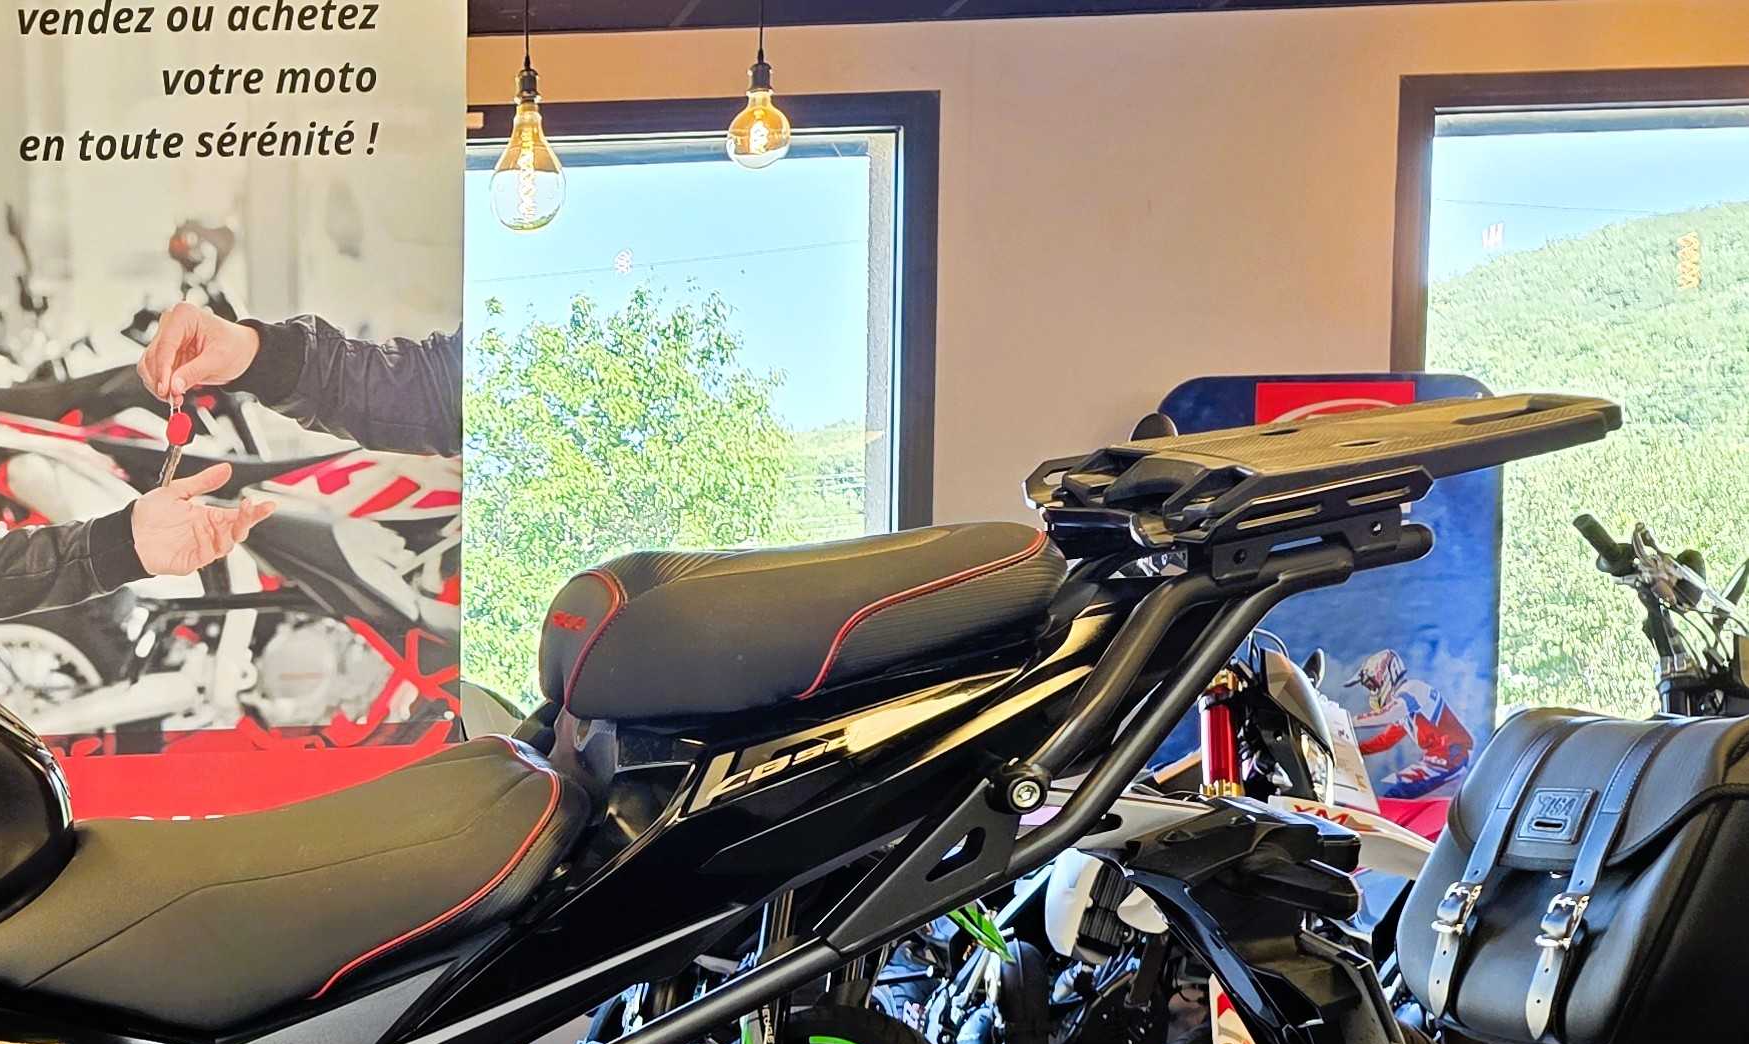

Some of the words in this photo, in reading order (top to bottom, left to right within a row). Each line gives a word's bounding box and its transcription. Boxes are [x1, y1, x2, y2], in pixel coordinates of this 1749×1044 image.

[18, 0, 154, 35] vendez
[166, 4, 213, 32] ou
[227, 0, 379, 31] achetez
[162, 63, 264, 95] votre
[276, 62, 377, 94] moto
[19, 134, 65, 162] en
[78, 128, 183, 161] toute
[195, 120, 354, 158] sérénité
[366, 122, 379, 155] !
